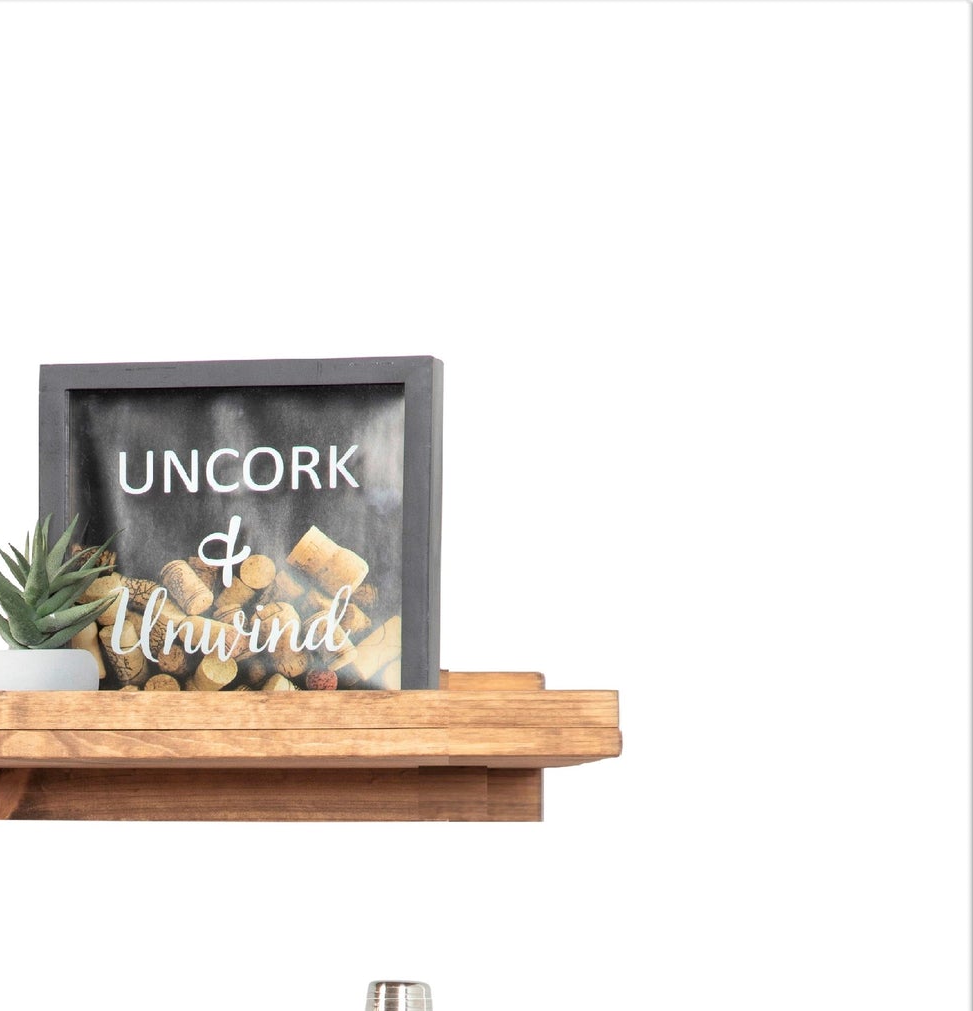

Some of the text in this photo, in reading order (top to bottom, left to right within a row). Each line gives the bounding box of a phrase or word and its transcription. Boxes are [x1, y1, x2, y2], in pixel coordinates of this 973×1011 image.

[119, 444, 359, 494] UNCORK
[197, 514, 251, 588] &
[109, 584, 352, 663] Unwind
